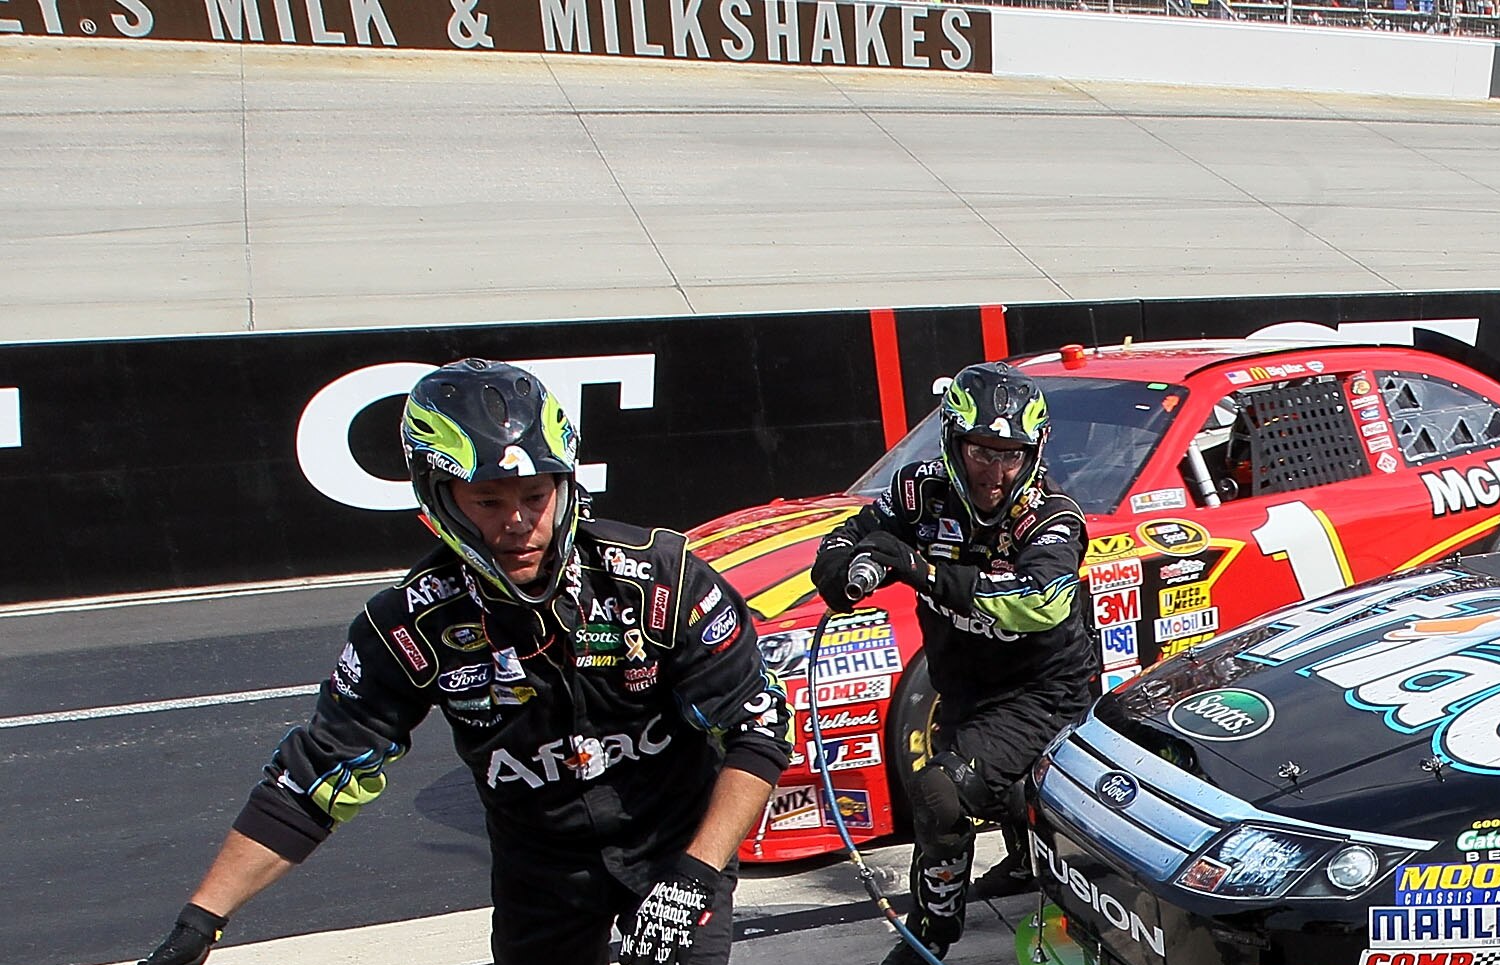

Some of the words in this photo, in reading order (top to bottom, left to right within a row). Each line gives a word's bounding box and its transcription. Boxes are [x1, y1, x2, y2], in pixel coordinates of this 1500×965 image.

[541, 0, 972, 70] MILKSHAKES
[426, 451, 472, 482] aflac.com
[1252, 500, 1346, 600] 1
[1091, 566, 1140, 586] Holley
[654, 588, 668, 628] SIMPSON
[1097, 590, 1138, 625] 3M
[1174, 597, 1207, 612] Meter
[1175, 586, 1201, 600] Auto
[575, 629, 620, 644] Scotts
[1160, 617, 1199, 634] Mobil
[1202, 610, 1214, 627] 1
[394, 629, 424, 669] SIMPSON
[1105, 624, 1135, 655] USG
[448, 667, 487, 690] Ford
[487, 714, 672, 789] Aflac
[1101, 775, 1134, 803] Ford
[1033, 837, 1166, 958] FUSION
[1404, 889, 1472, 906] CHASSIS
